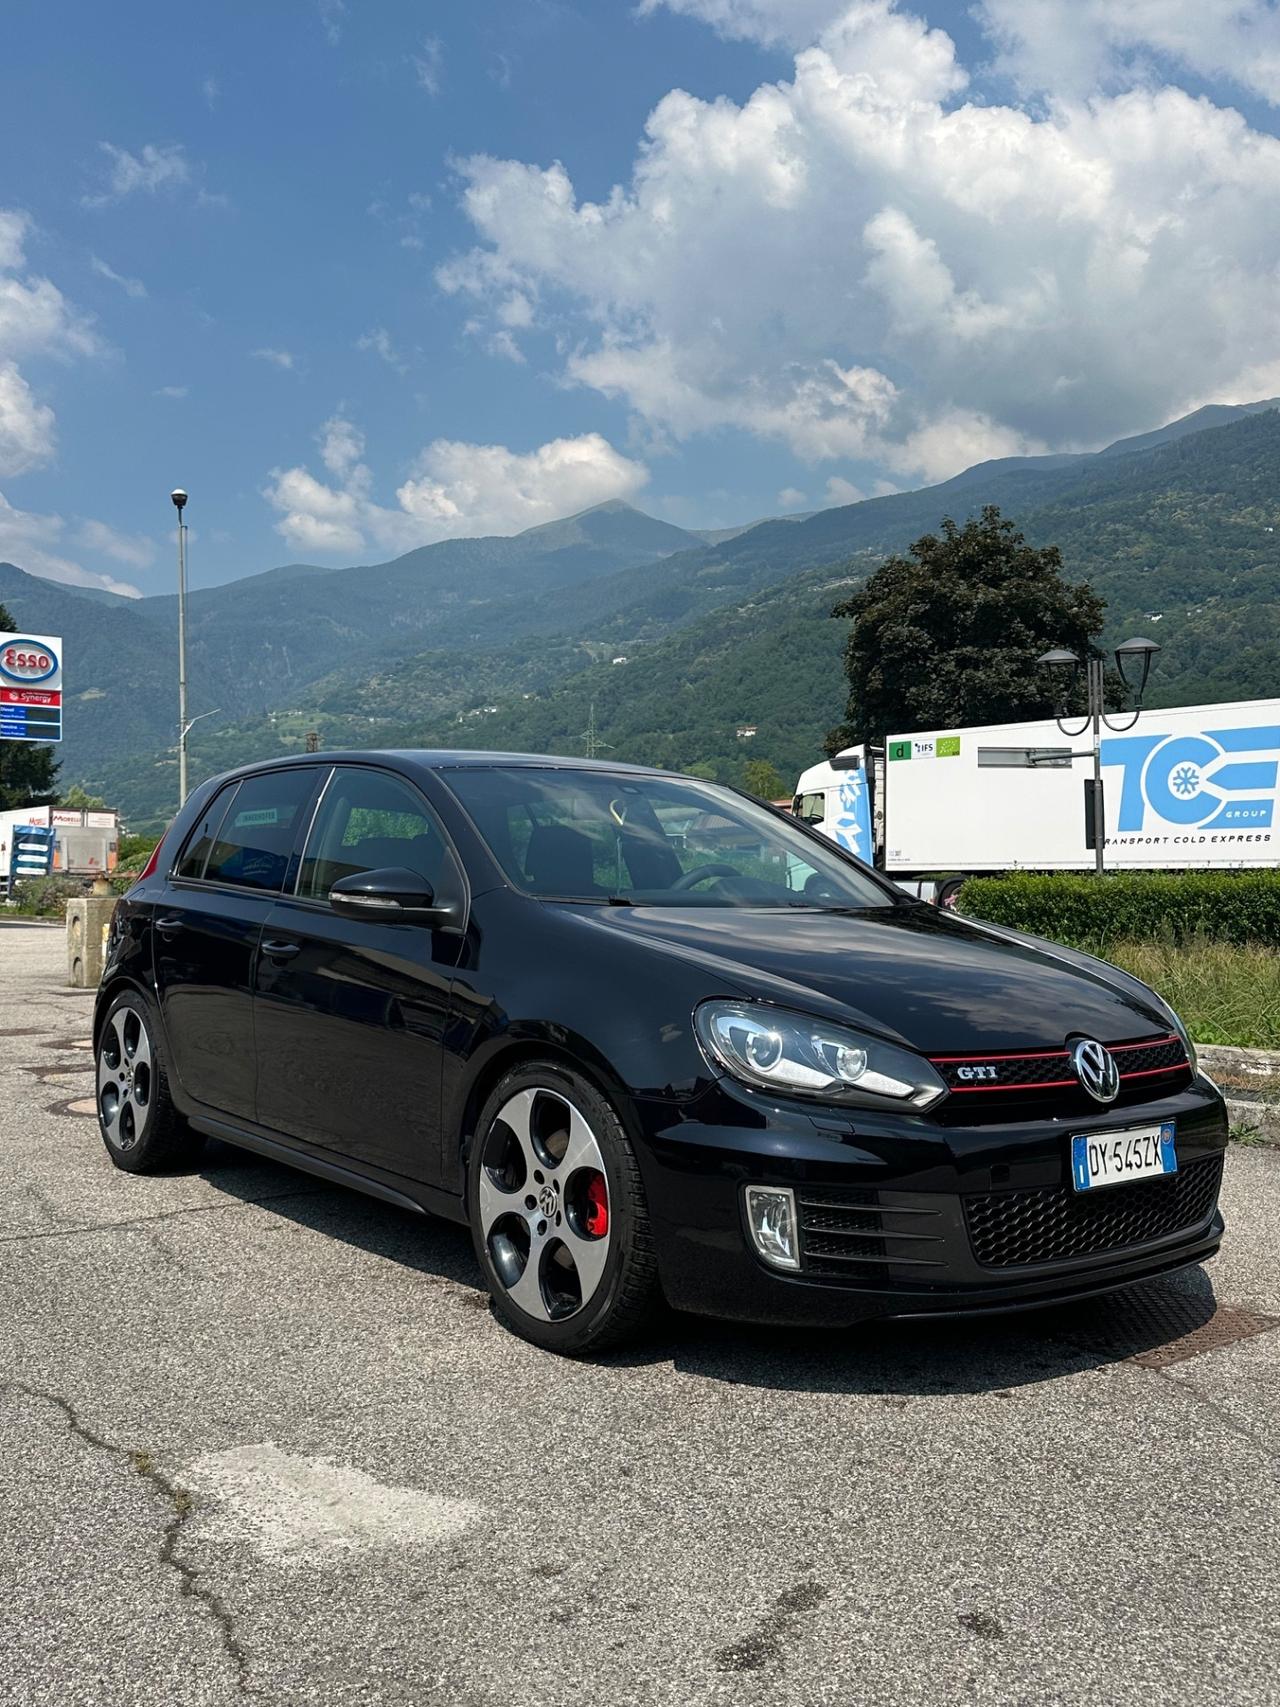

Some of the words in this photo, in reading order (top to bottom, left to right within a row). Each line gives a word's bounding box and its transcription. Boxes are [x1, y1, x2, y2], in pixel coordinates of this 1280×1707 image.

[21, 692, 52, 704] Synergy
[896, 744, 904, 758] d
[921, 743, 933, 752] IFS
[1225, 809, 1267, 818] GROUP
[1104, 837, 1170, 846] RANSPORT
[1173, 836, 1207, 844] COLD
[1210, 834, 1272, 843] EXPRESS
[957, 1066, 998, 1080] GTI
[1088, 1142, 1108, 1176] DY
[1112, 1134, 1163, 1172] 545ZX
